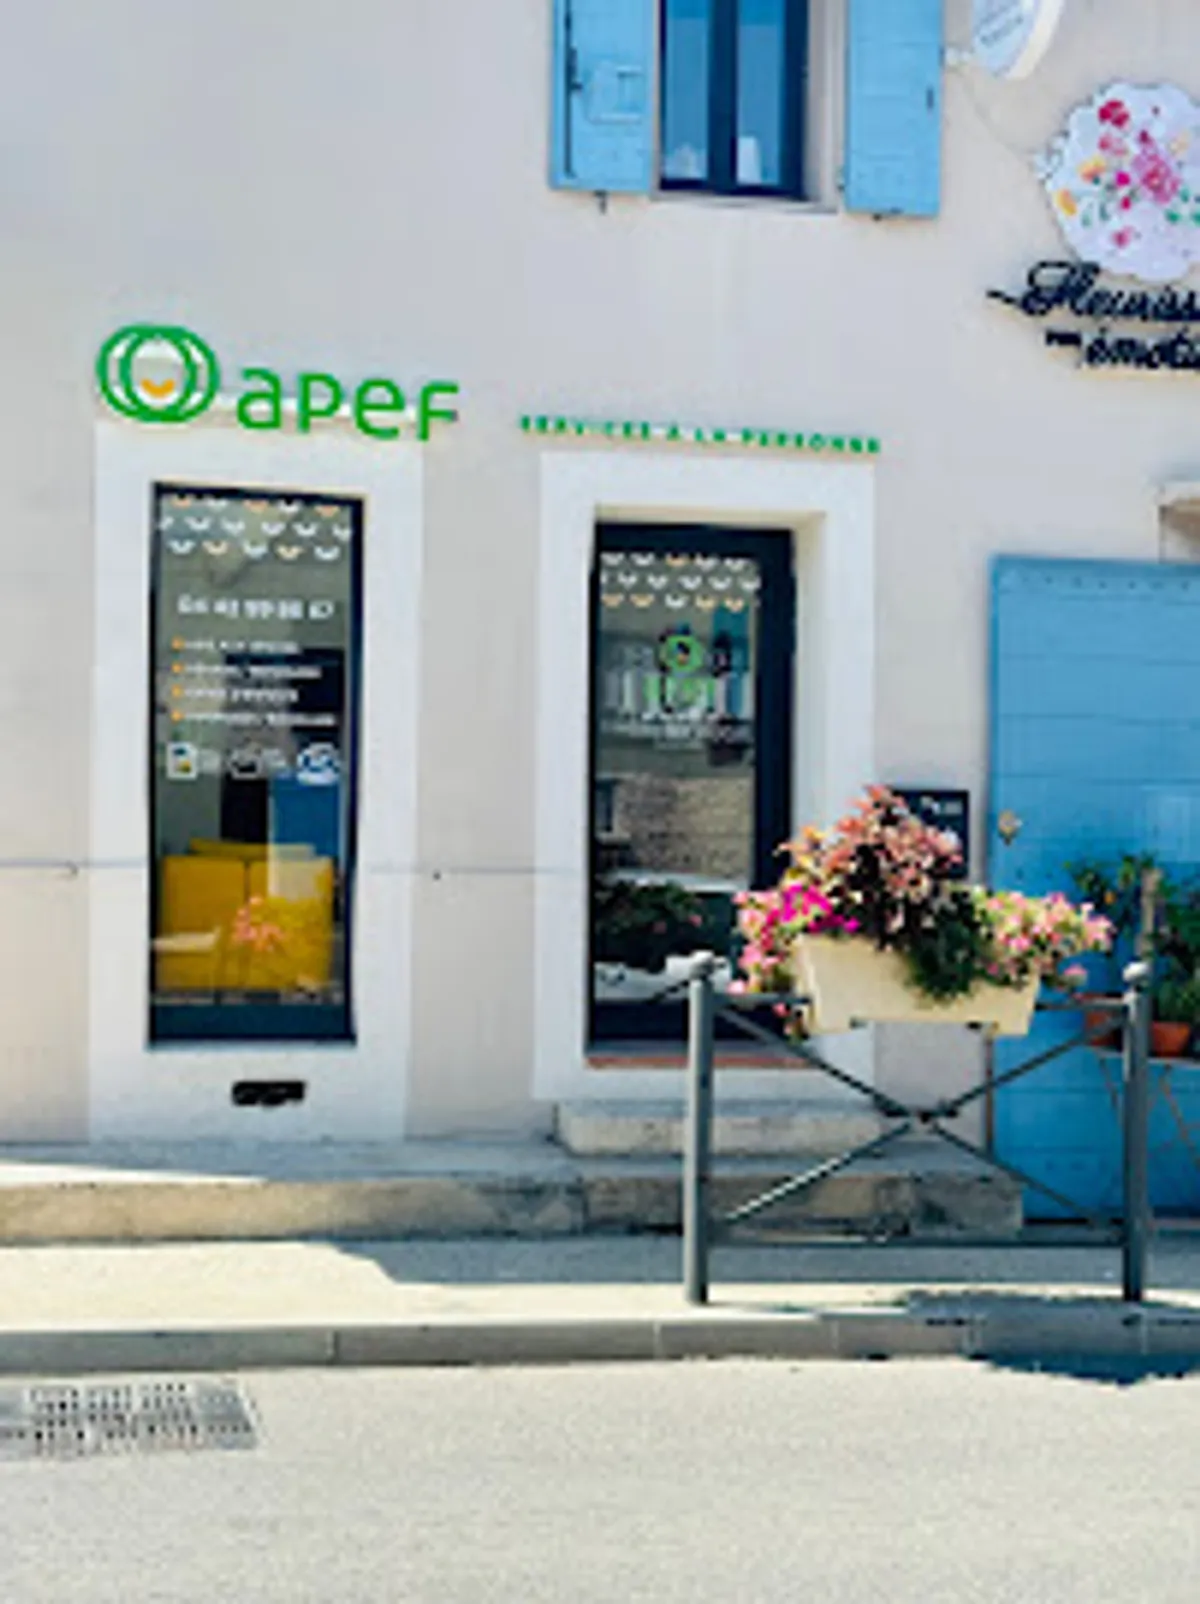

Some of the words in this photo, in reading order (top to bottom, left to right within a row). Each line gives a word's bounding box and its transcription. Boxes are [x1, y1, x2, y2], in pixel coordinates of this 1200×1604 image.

[236, 366, 460, 442] apef
[519, 413, 651, 441] SERVICES
[741, 427, 881, 453] PERSONNE
